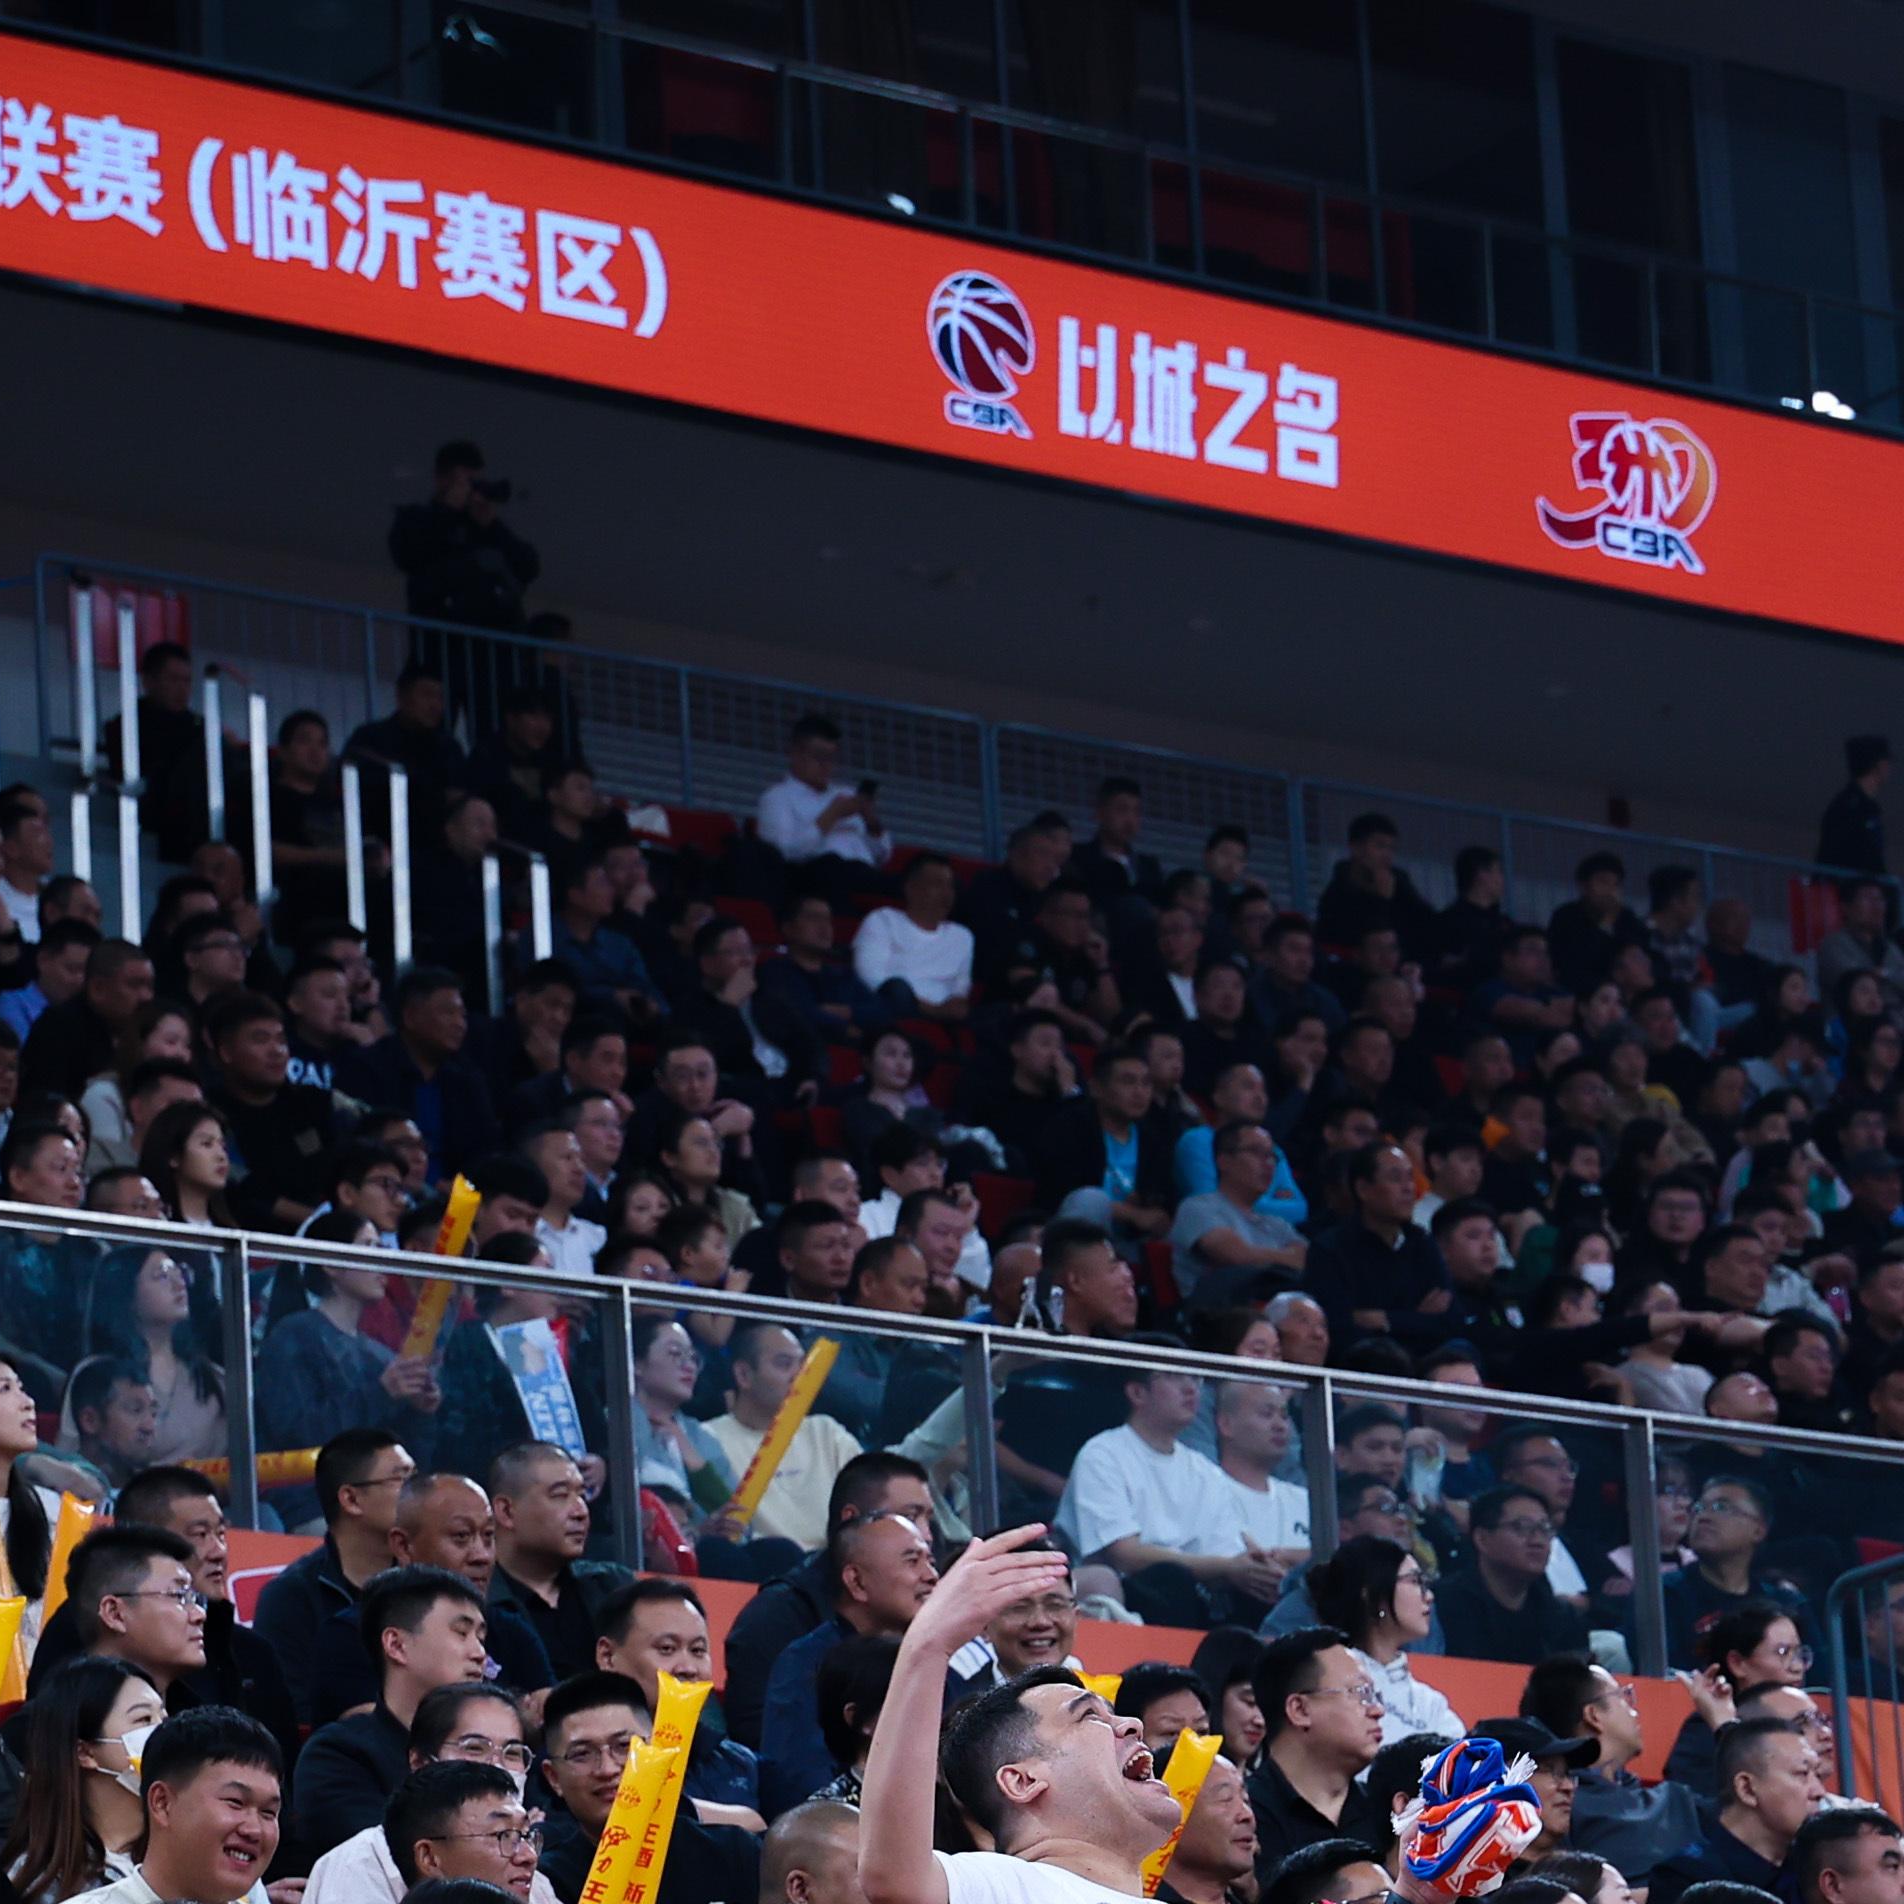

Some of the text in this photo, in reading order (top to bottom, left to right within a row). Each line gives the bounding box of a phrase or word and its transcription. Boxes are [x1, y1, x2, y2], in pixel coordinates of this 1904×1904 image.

[946, 396, 1031, 438] CBA
[1058, 315, 1339, 488] 以城之名
[1597, 514, 1705, 573] CBA
